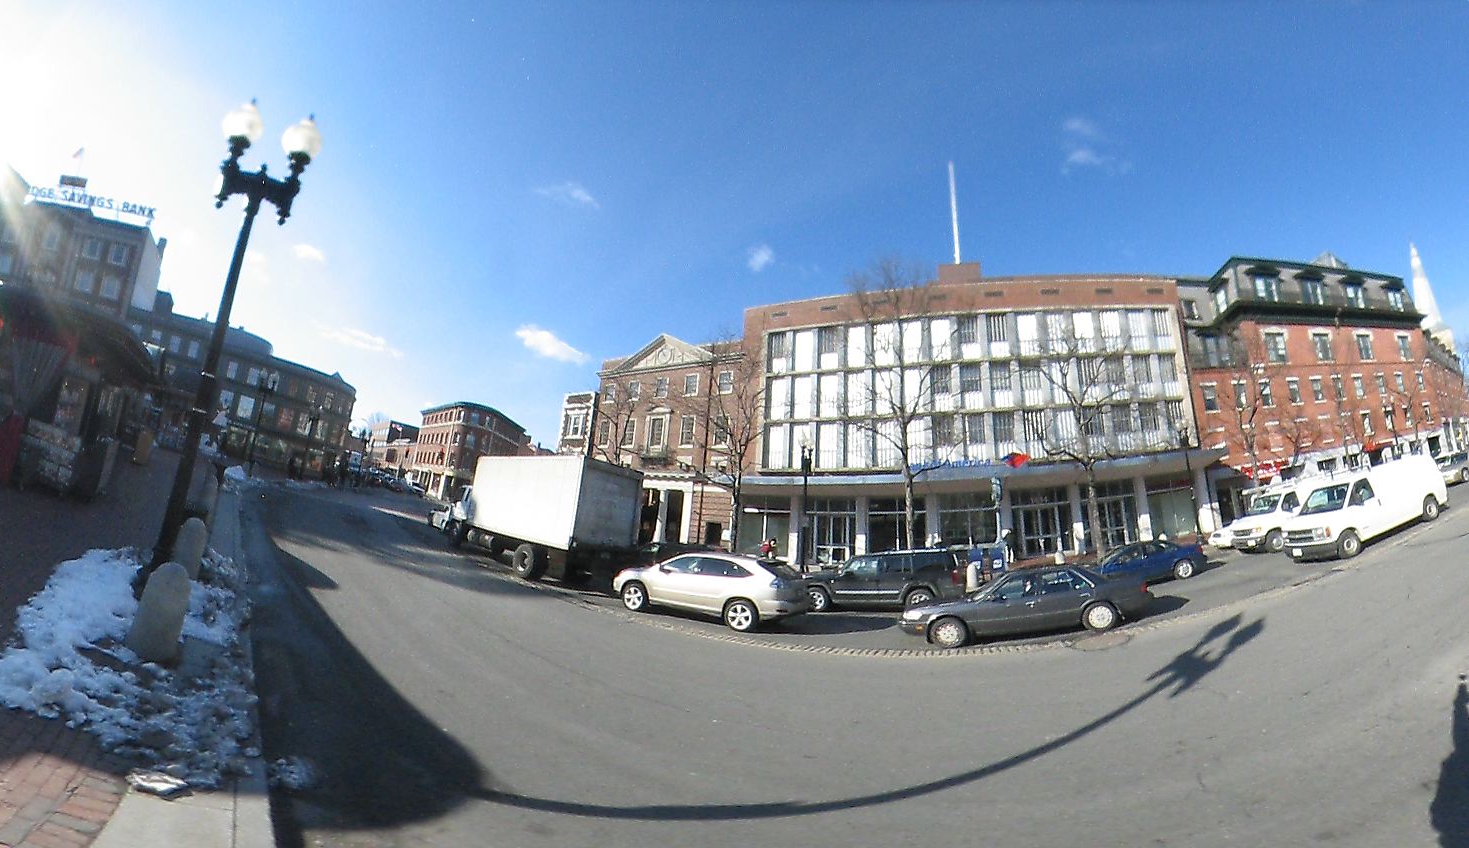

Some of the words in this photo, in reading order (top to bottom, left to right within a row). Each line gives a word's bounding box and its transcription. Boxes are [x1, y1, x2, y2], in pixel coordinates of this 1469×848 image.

[31, 186, 55, 199] DGE
[61, 190, 113, 209] SAVINGS
[122, 201, 156, 218] BANK
